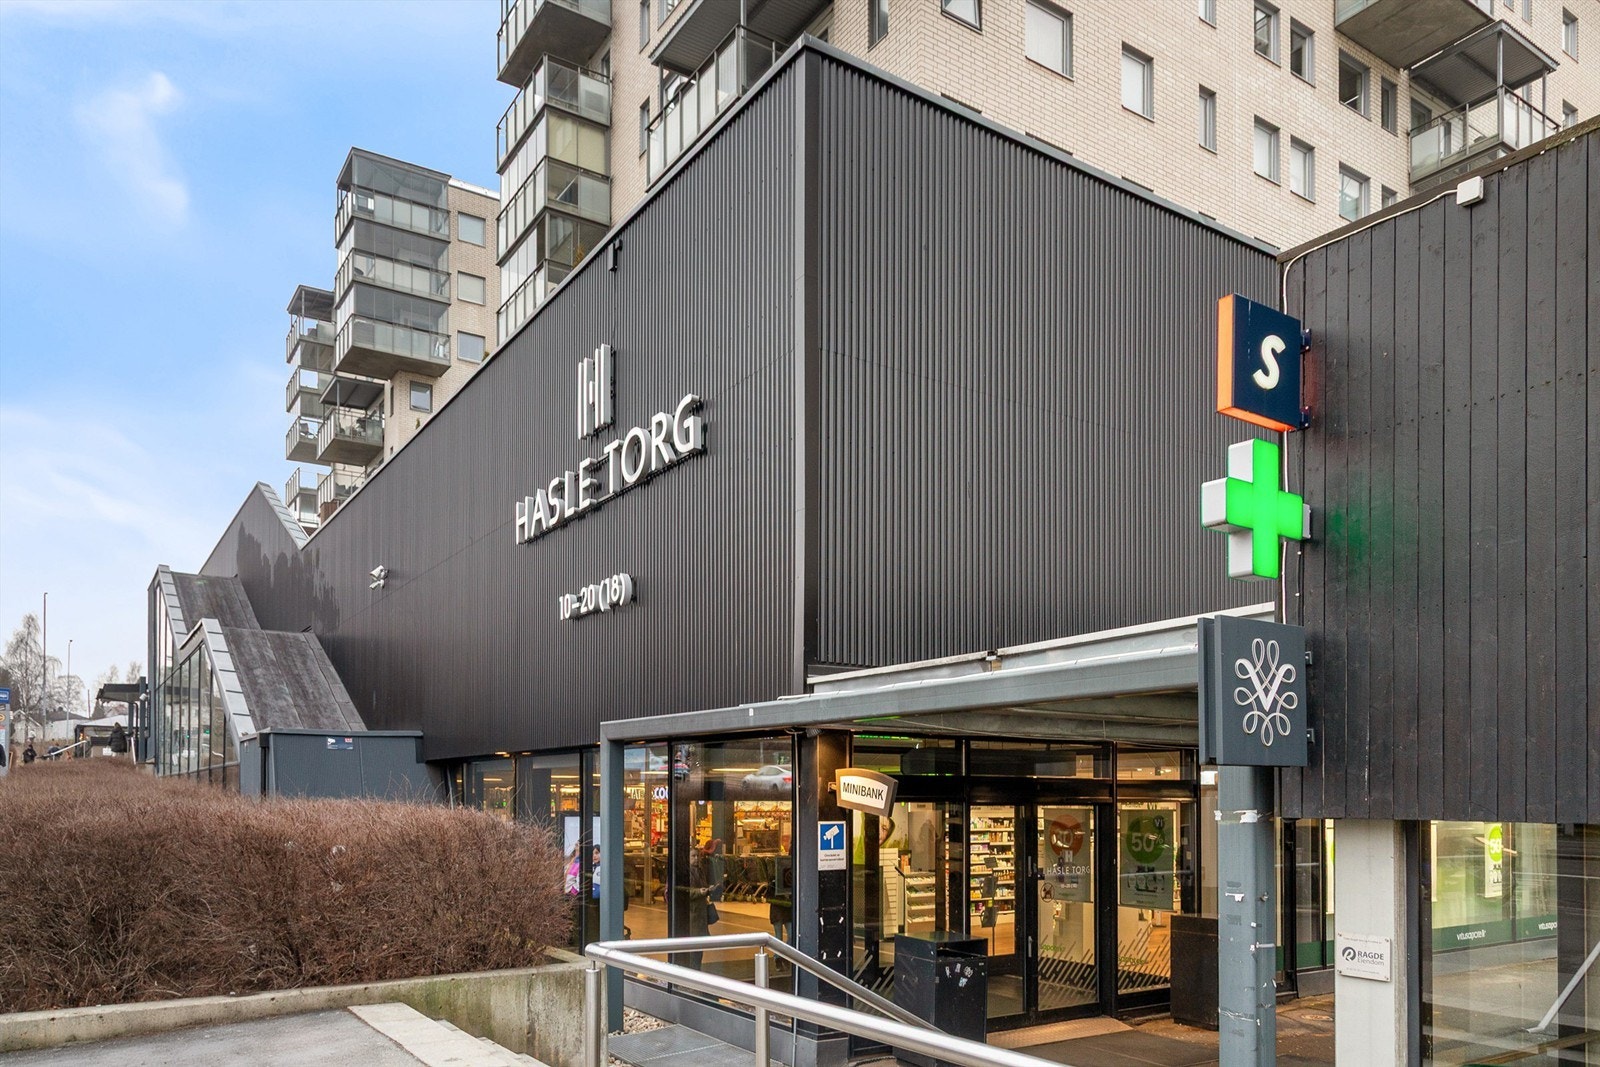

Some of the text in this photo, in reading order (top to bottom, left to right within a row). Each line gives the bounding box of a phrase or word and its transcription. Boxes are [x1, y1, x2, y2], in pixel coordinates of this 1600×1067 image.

[1252, 333, 1286, 390] S
[515, 392, 703, 545] HASLE TORG
[598, 572, 633, 612] (18)
[842, 781, 884, 801] MINIBANK
[1047, 865, 1091, 876] HASLE TORG
[1357, 950, 1385, 961] RAGDE
[1357, 958, 1385, 966] Eiendom
